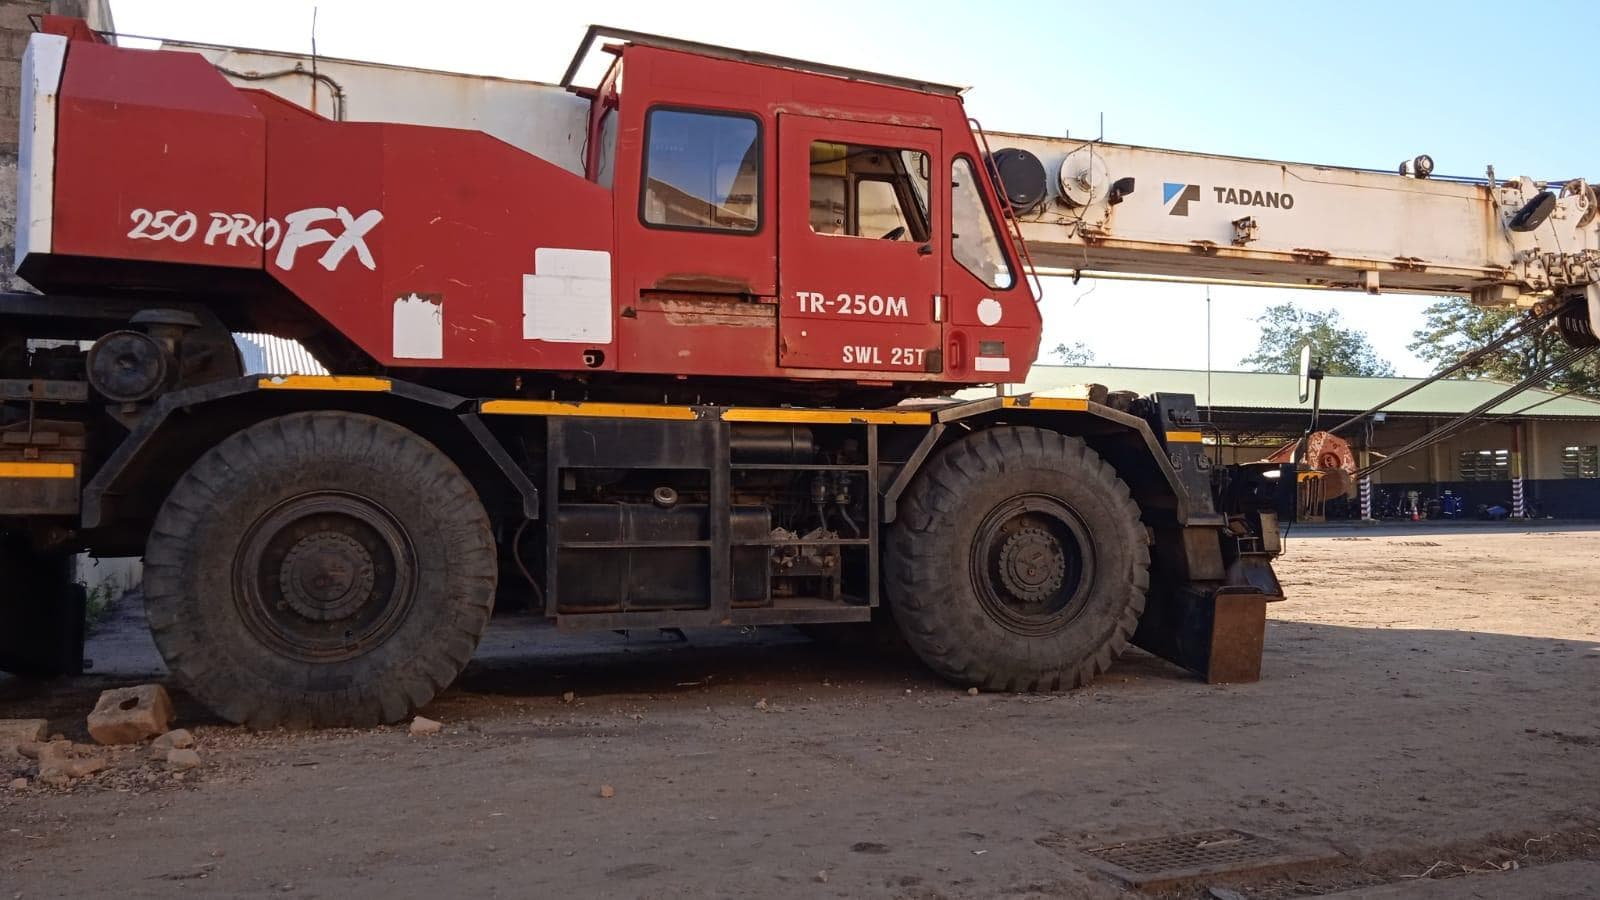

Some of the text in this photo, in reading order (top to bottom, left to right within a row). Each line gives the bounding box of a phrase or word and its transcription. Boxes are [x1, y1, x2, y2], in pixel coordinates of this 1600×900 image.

[1213, 186, 1294, 210] TADANO
[127, 206, 384, 271] 250 PRO FX
[796, 291, 909, 317] TR-250M
[842, 345, 926, 366] SWL 25T
